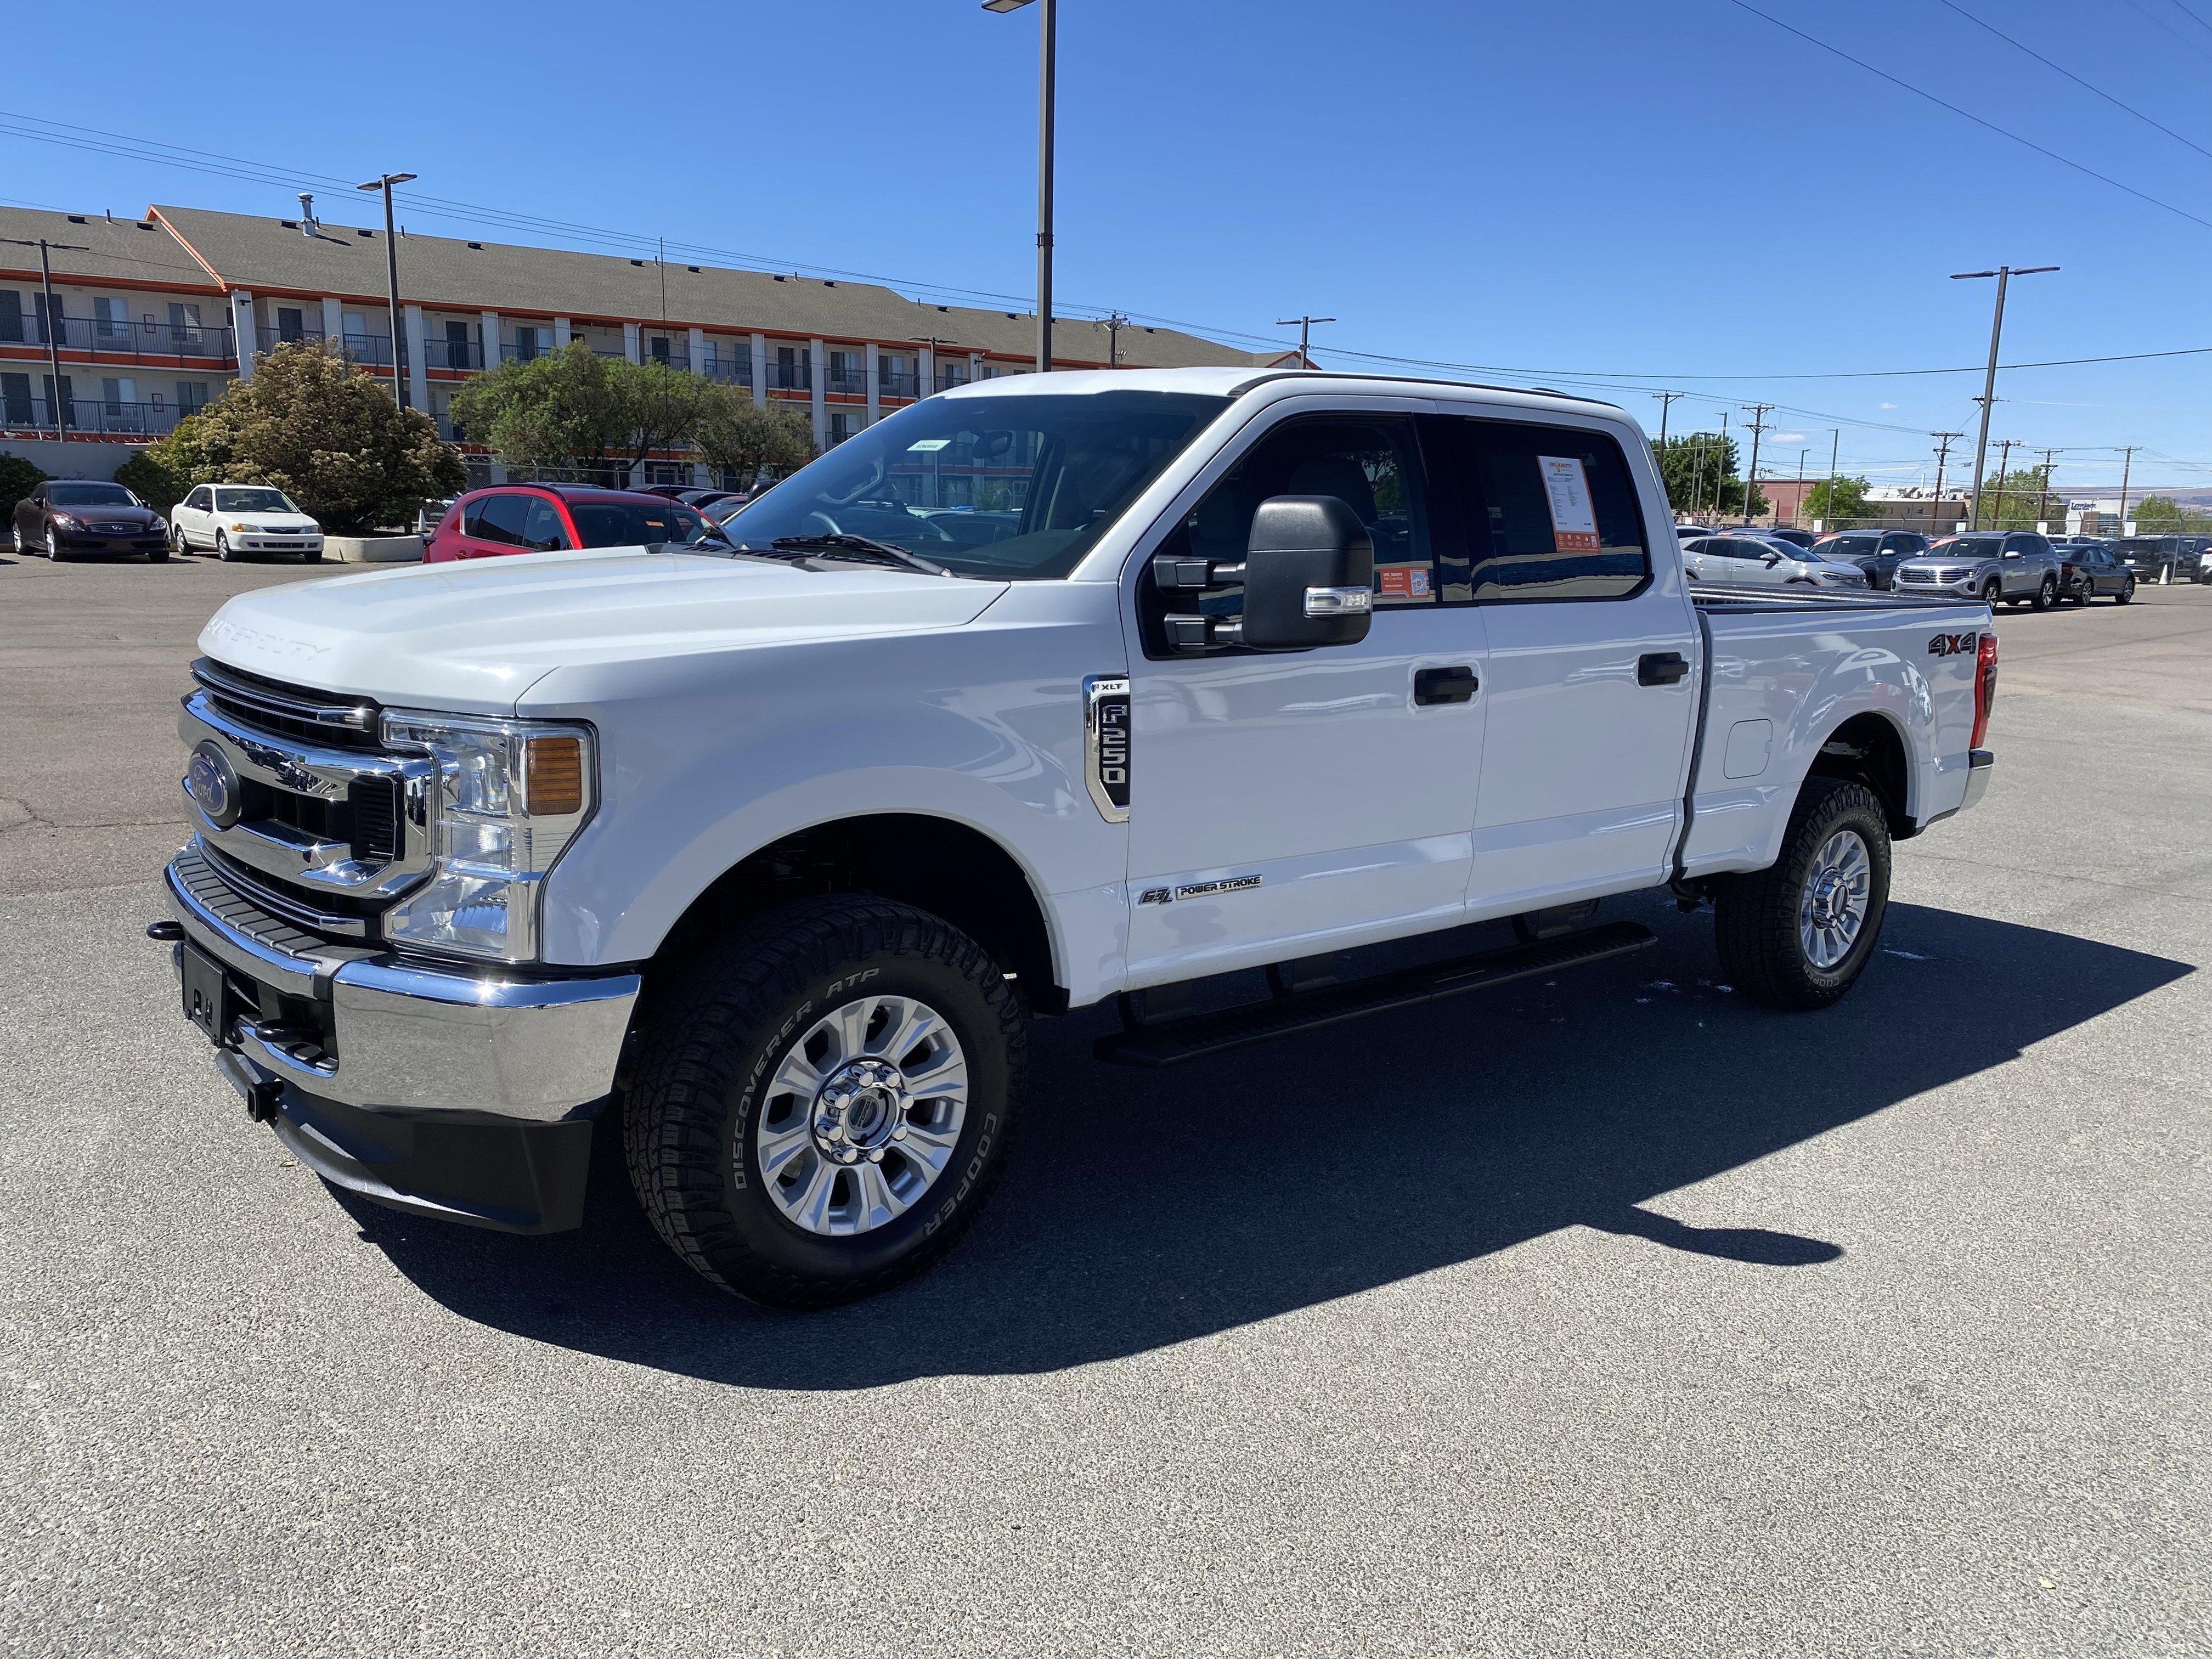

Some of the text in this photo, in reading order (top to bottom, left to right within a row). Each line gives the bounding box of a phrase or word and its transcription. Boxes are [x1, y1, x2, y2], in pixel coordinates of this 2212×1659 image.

[194, 765, 214, 803] Ford
[1180, 876, 1261, 896] POWER STROKE
[1803, 963, 1839, 987] COOPER
[732, 968, 879, 1189] DISCOVERER ATP
[923, 1113, 997, 1236] COOPER
